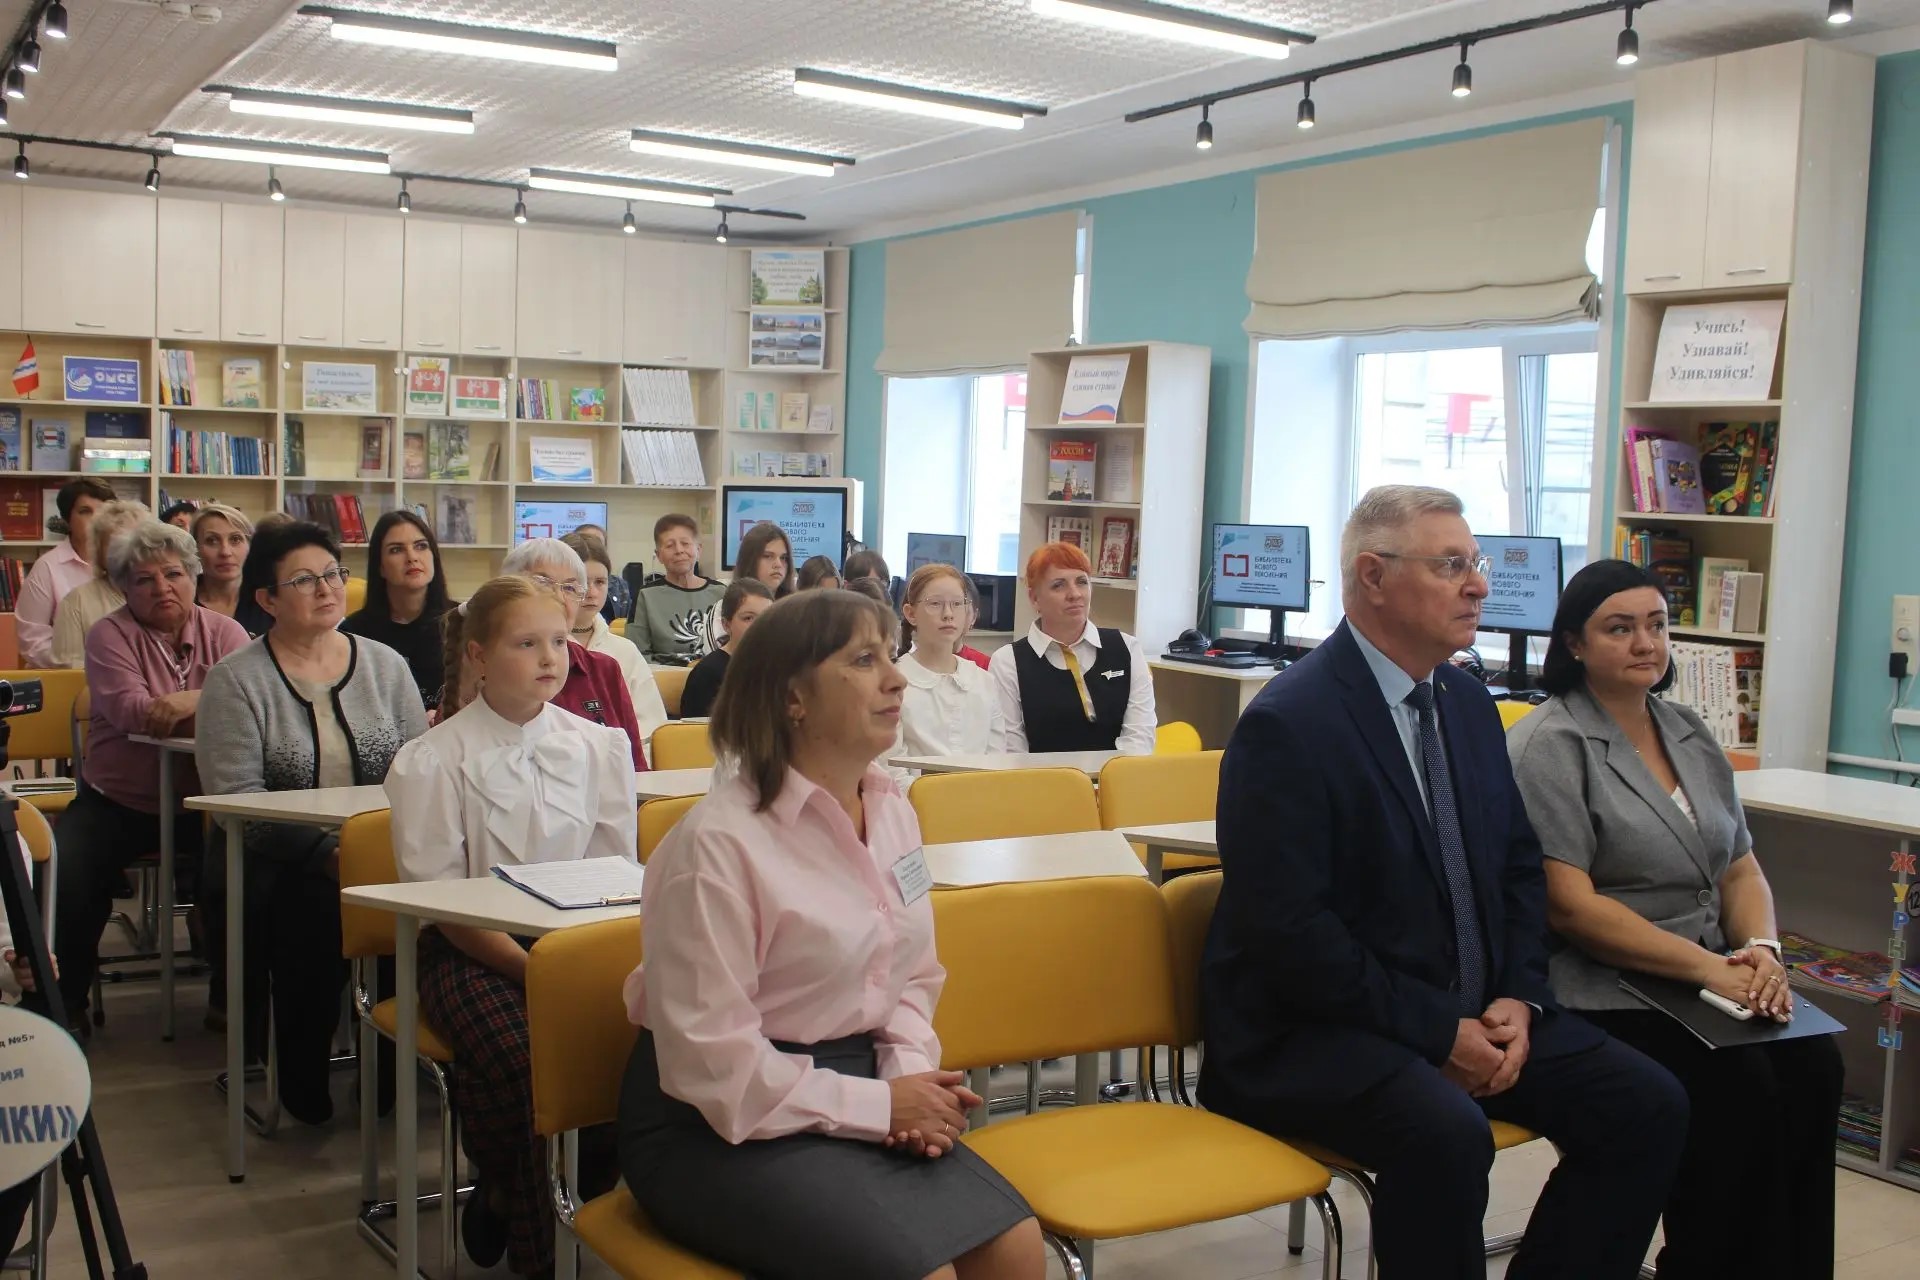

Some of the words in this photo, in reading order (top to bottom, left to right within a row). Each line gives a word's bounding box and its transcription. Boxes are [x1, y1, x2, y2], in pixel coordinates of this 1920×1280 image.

[1693, 319, 1745, 335] Учись!
[1682, 341, 1749, 358] Узнавай!
[95, 371, 137, 385] ОМСК
[1670, 364, 1755, 380] Удивляйся!
[1491, 571, 1540, 580] БИБЛИОТЕКА
[0, 1067, 24, 1082] ия
